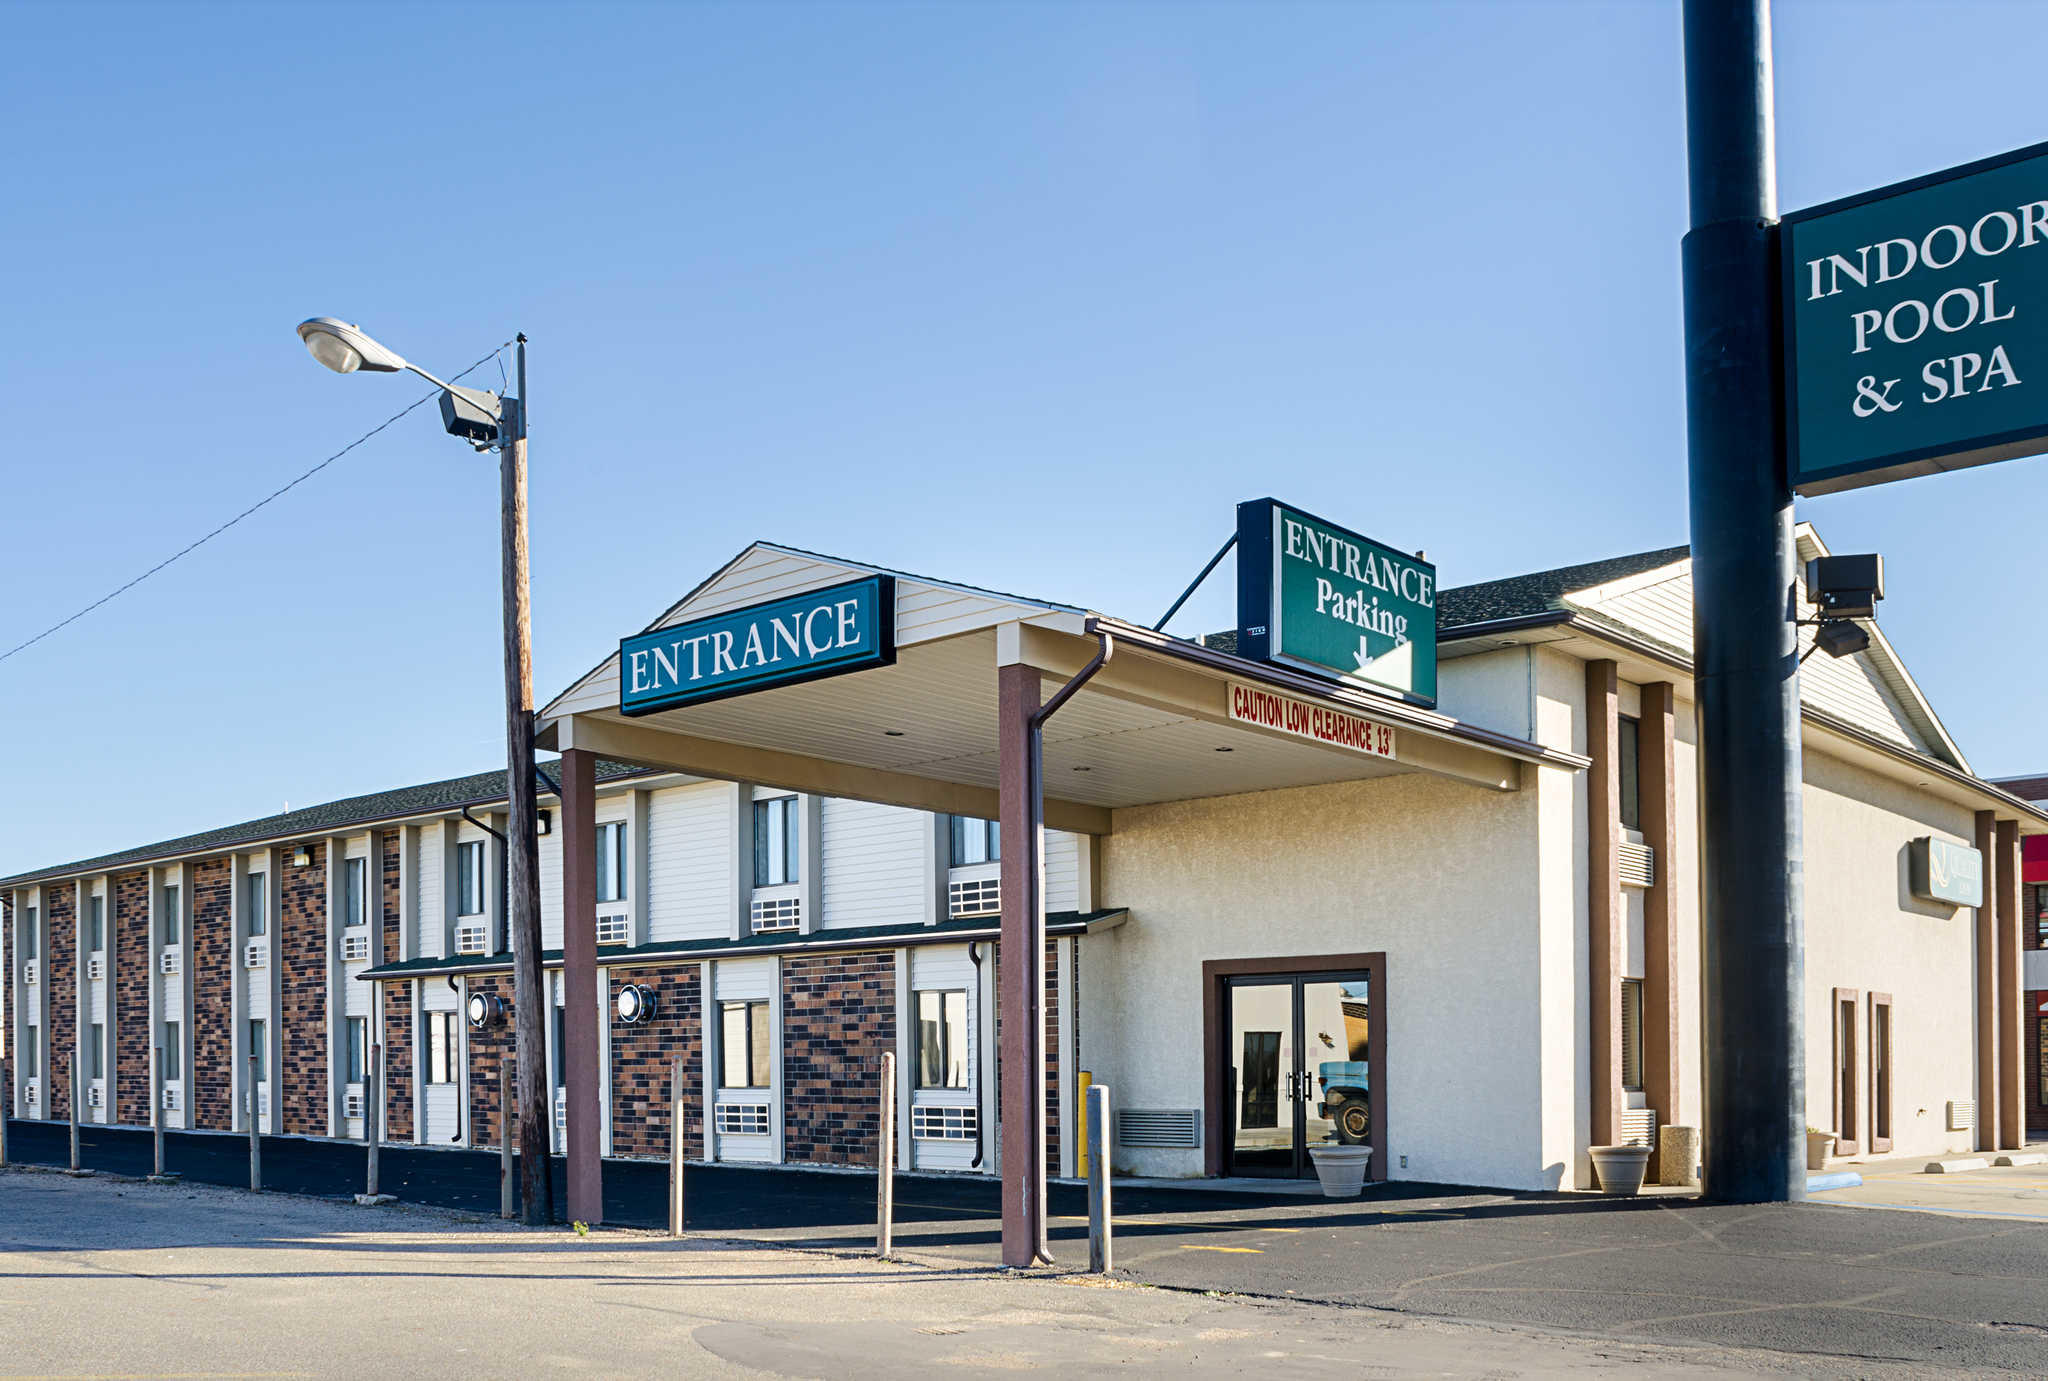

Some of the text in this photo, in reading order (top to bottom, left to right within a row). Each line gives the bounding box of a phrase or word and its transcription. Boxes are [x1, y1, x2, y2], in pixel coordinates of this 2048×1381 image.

[1806, 200, 2048, 301] INDOOR
[1851, 280, 2015, 354] POOL
[1852, 345, 2022, 417] & SPA
[1285, 519, 1433, 608] ENTRANCE
[629, 599, 861, 694] ENTRANCE
[1316, 577, 1408, 647] Parking
[1234, 687, 1283, 730] CAUTION
[1286, 696, 1310, 737] LOW
[1313, 706, 1372, 751] CLEARANCE
